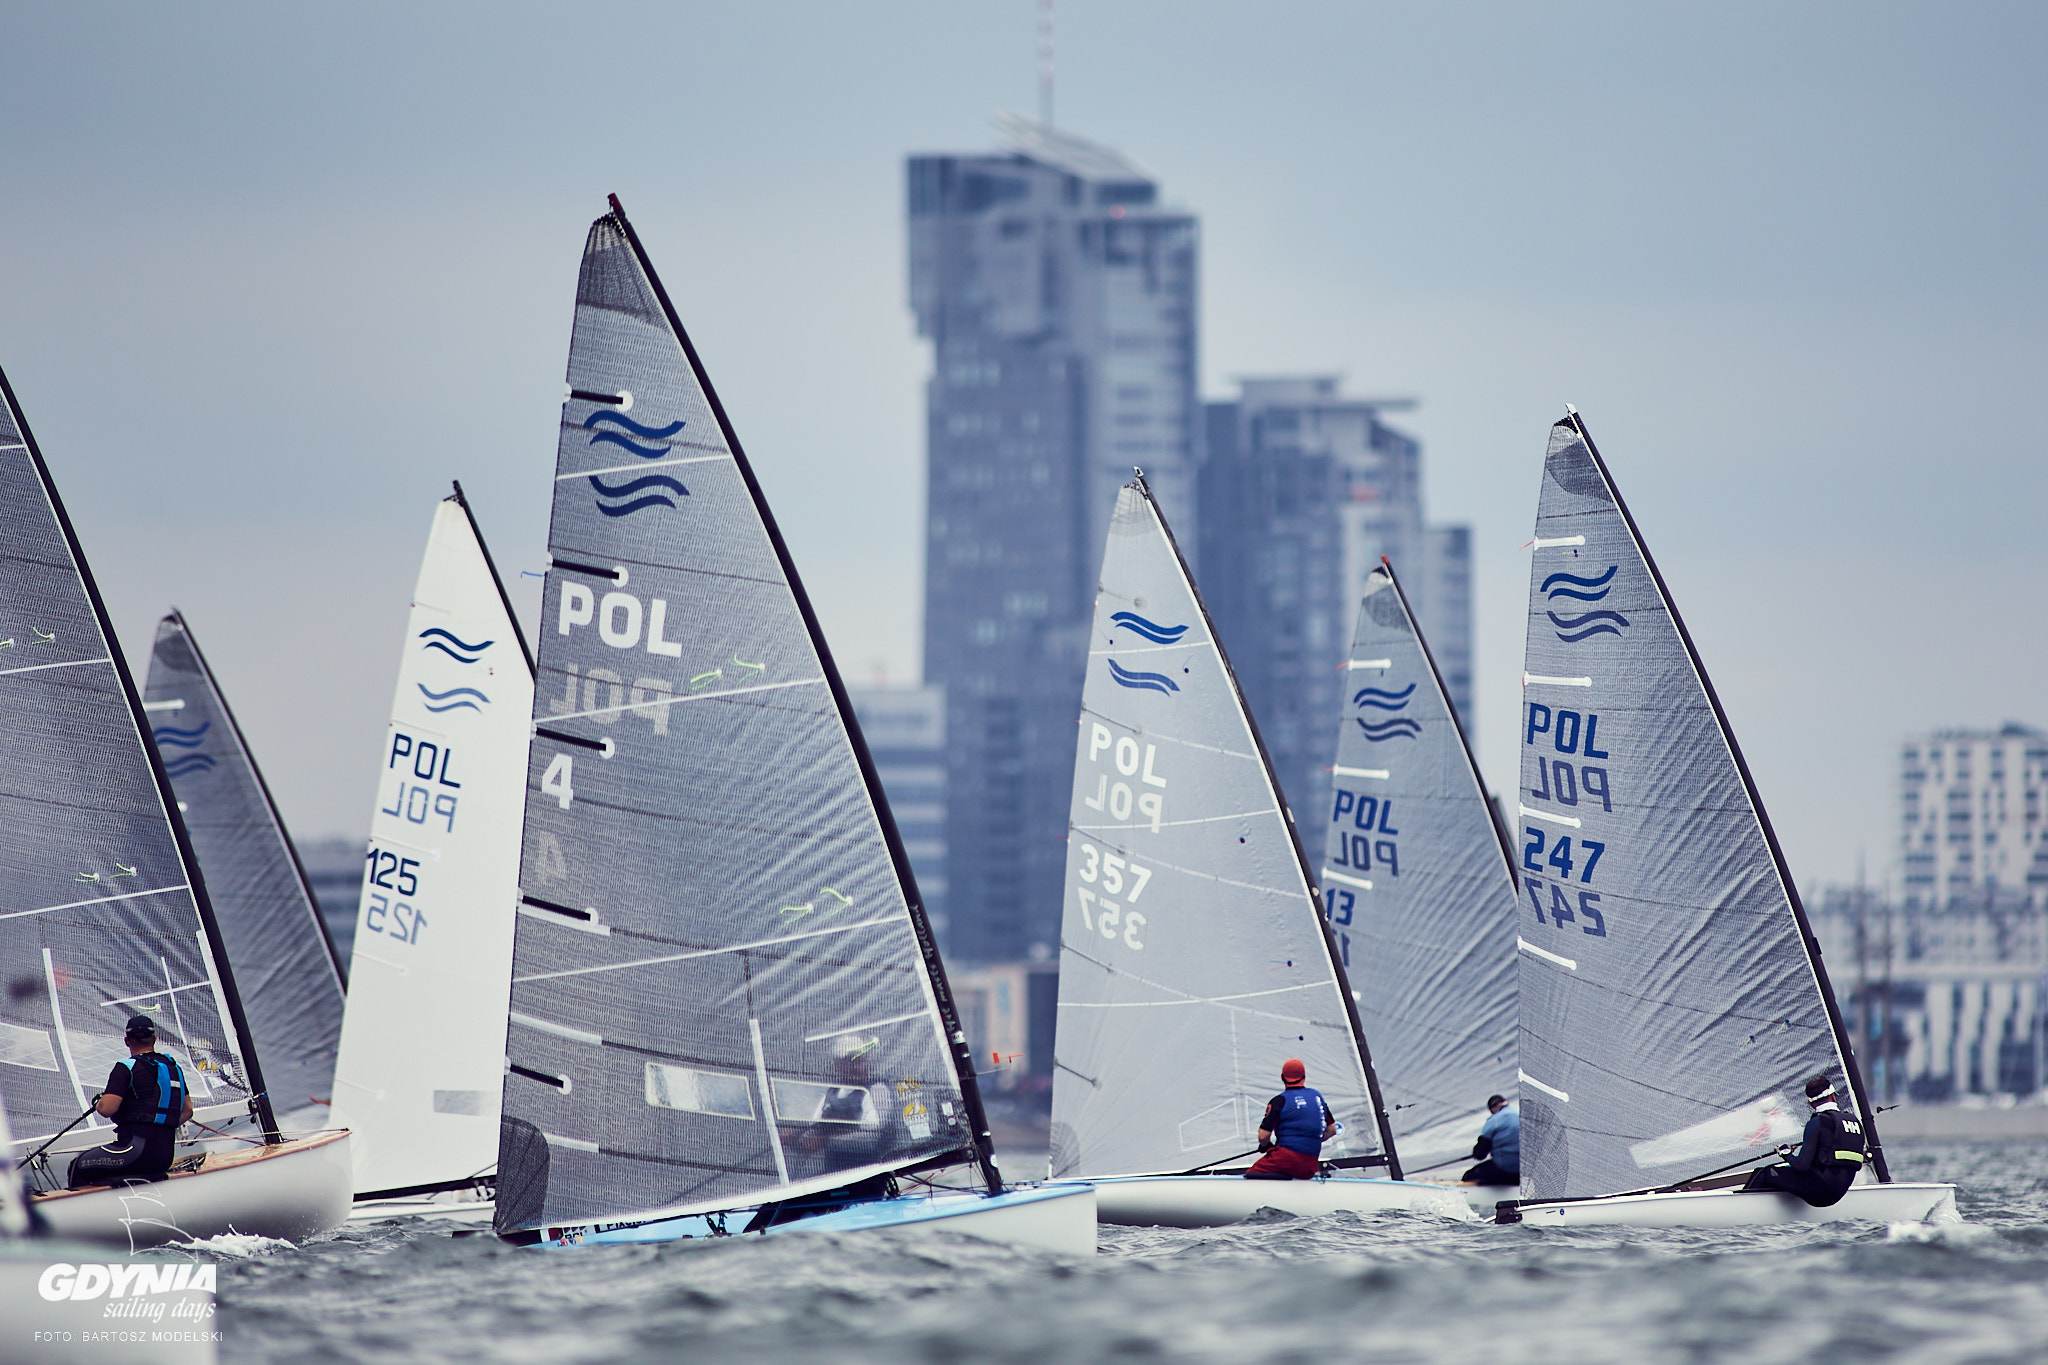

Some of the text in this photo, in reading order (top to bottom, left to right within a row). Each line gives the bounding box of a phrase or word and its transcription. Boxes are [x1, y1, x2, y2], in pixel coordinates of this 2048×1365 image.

[558, 580, 682, 658] POL
[1089, 722, 1167, 788] POL
[1527, 702, 1608, 760] POL
[390, 733, 461, 789] POL
[541, 753, 574, 810] 4
[1333, 789, 1399, 836] POL
[367, 848, 420, 896] 125
[1079, 843, 1152, 903] 357
[1524, 826, 1606, 884] 247
[1326, 888, 1356, 927] 13
[1842, 1120, 1861, 1135] HH
